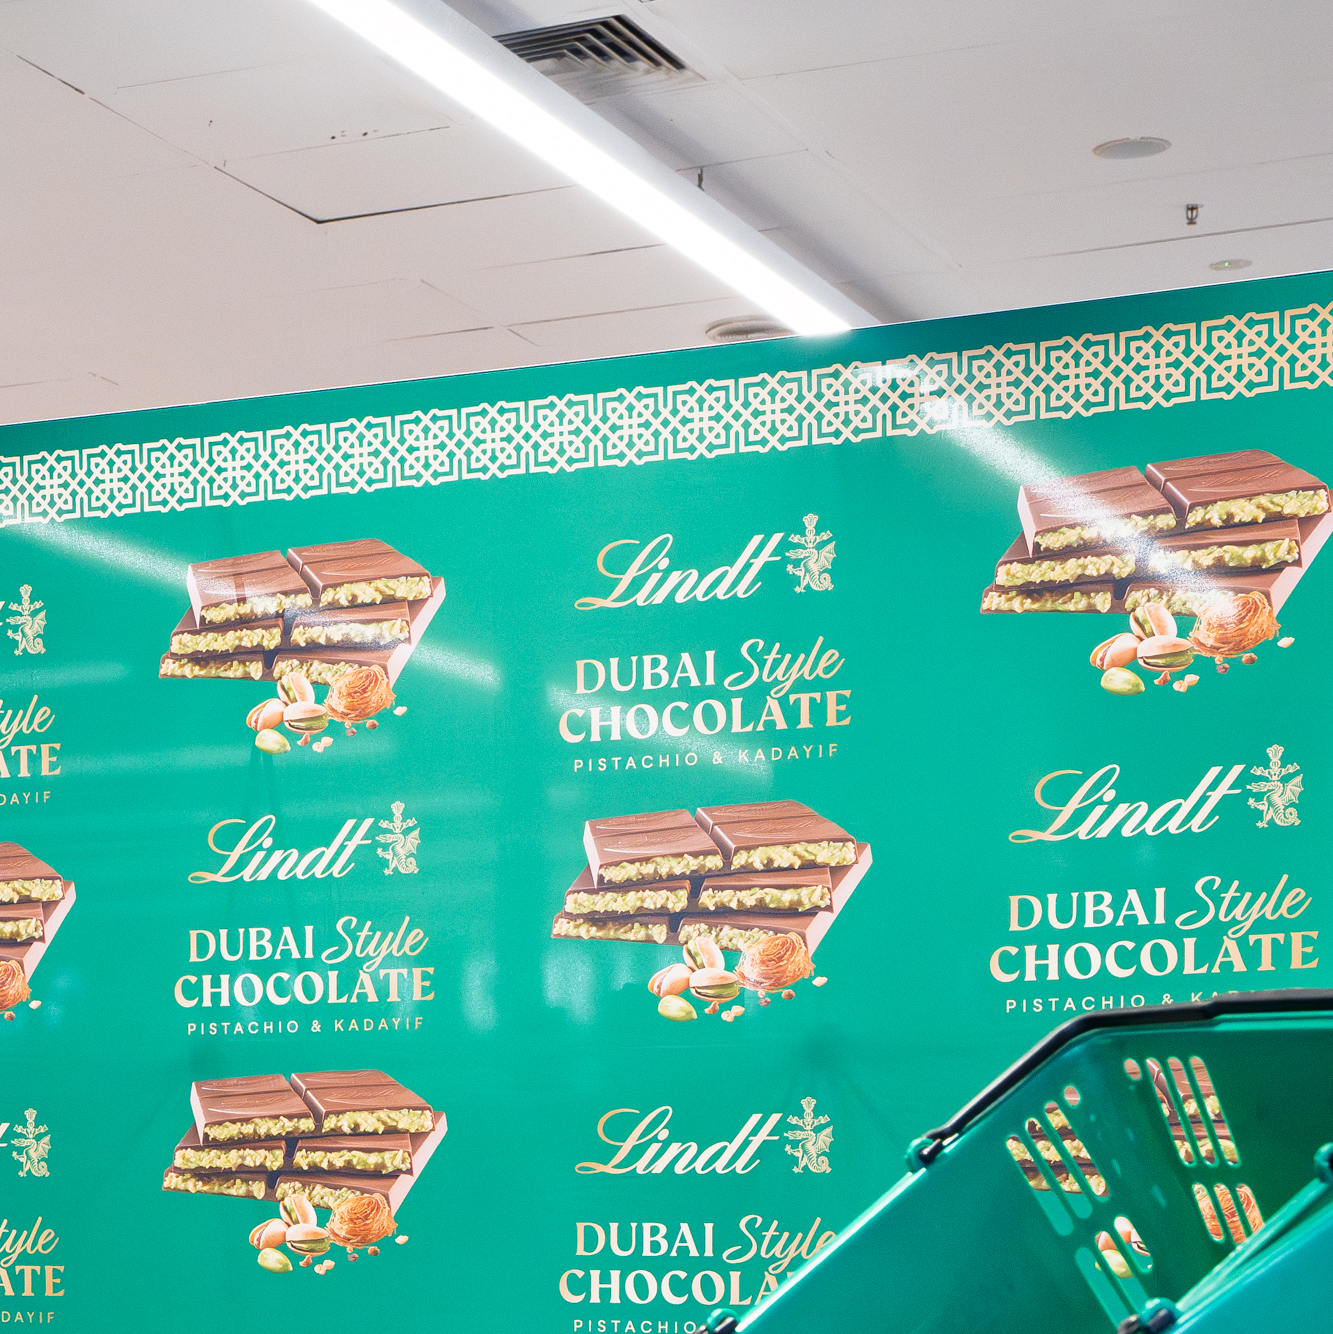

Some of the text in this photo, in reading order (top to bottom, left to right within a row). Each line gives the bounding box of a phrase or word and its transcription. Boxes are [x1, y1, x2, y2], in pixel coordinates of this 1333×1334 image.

[574, 533, 785, 610] Lindt
[575, 636, 845, 698] DUBAI Style
[559, 690, 852, 743] CHOCOLATE
[574, 744, 838, 772] PISTACHIO & KADAYIF
[1009, 764, 1246, 843] Lindt
[188, 815, 375, 884] Lindt
[1009, 874, 1312, 938] DUBAI Style
[189, 916, 429, 972] DUBAI Style
[990, 931, 1319, 982] CHOCOLATE
[174, 967, 434, 1008] CHOCOLATE
[1006, 993, 1173, 1013] PISTACHIO &
[188, 1017, 423, 1035] PISTACHIO & KADAYIF
[575, 1106, 783, 1175] Lindt
[576, 1222, 714, 1257] DUBAI
[574, 1320, 696, 1334] PISTACHIO
